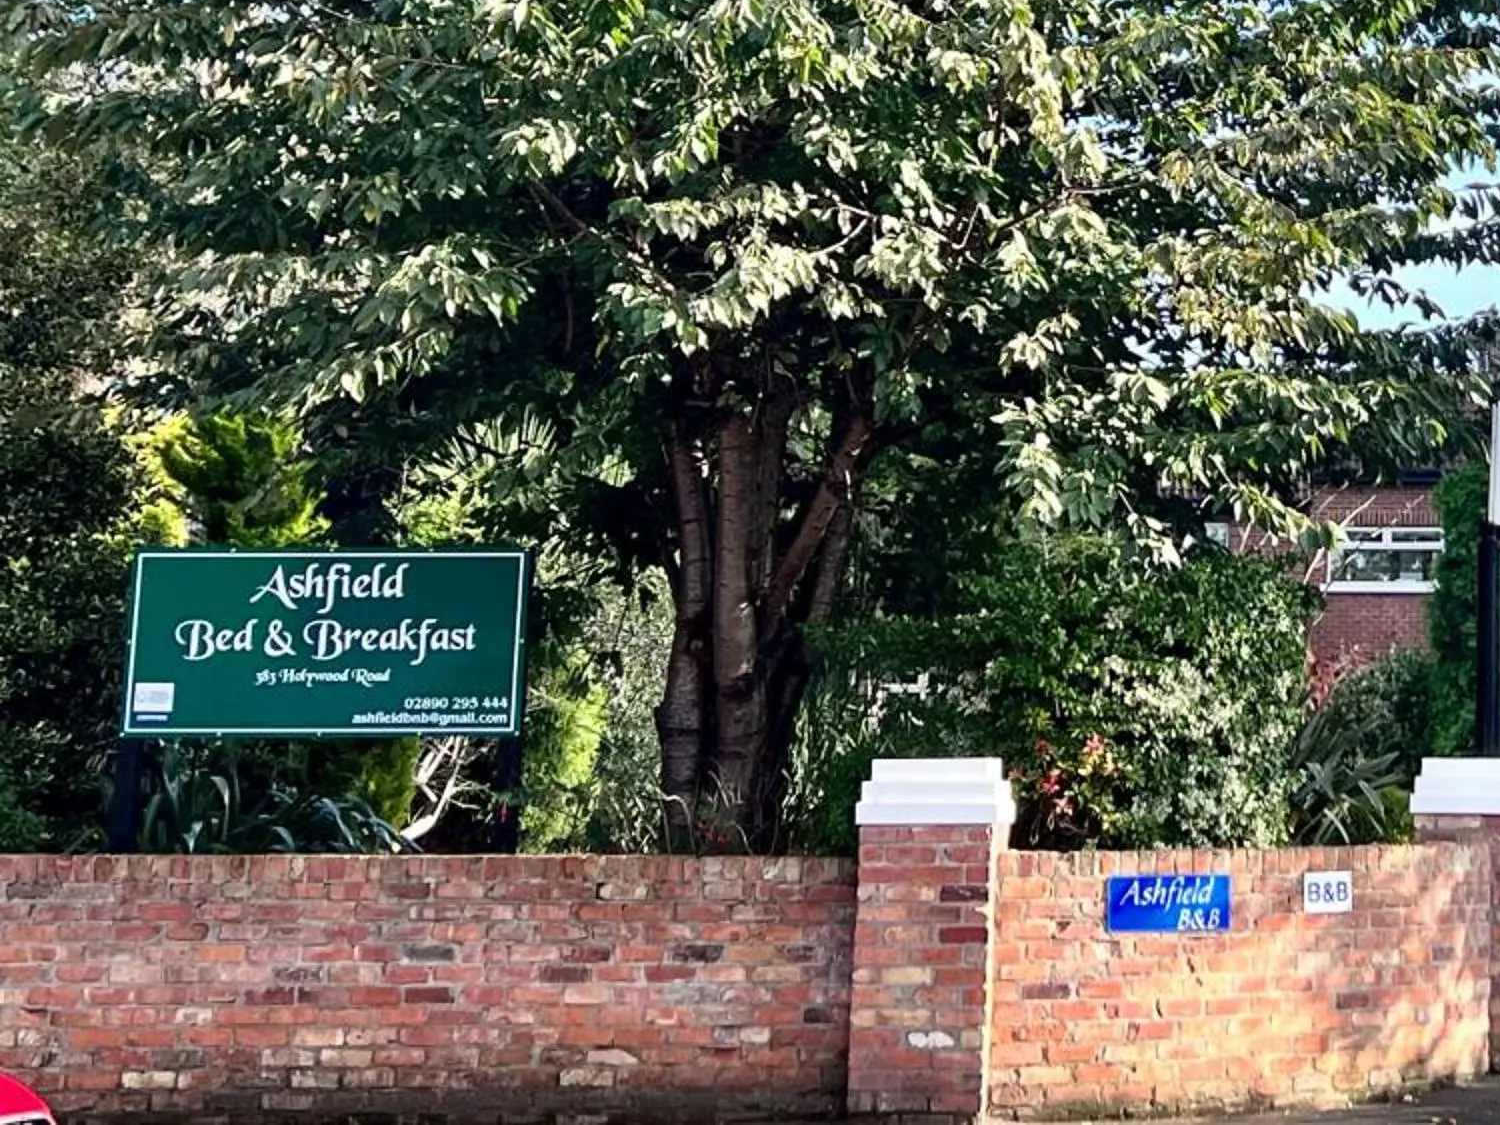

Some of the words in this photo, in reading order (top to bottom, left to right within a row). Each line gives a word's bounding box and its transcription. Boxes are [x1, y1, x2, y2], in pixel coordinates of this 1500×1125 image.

[249, 563, 410, 614] Ashfield
[175, 619, 258, 660] Bed
[263, 619, 296, 657] &
[303, 619, 477, 666] Breakfast
[351, 667, 391, 687] Road
[404, 696, 449, 709] 02890
[481, 696, 508, 708] 444
[1119, 875, 1216, 912] Ashfield
[1307, 881, 1349, 903] B&B
[1177, 908, 1221, 931] B&B
